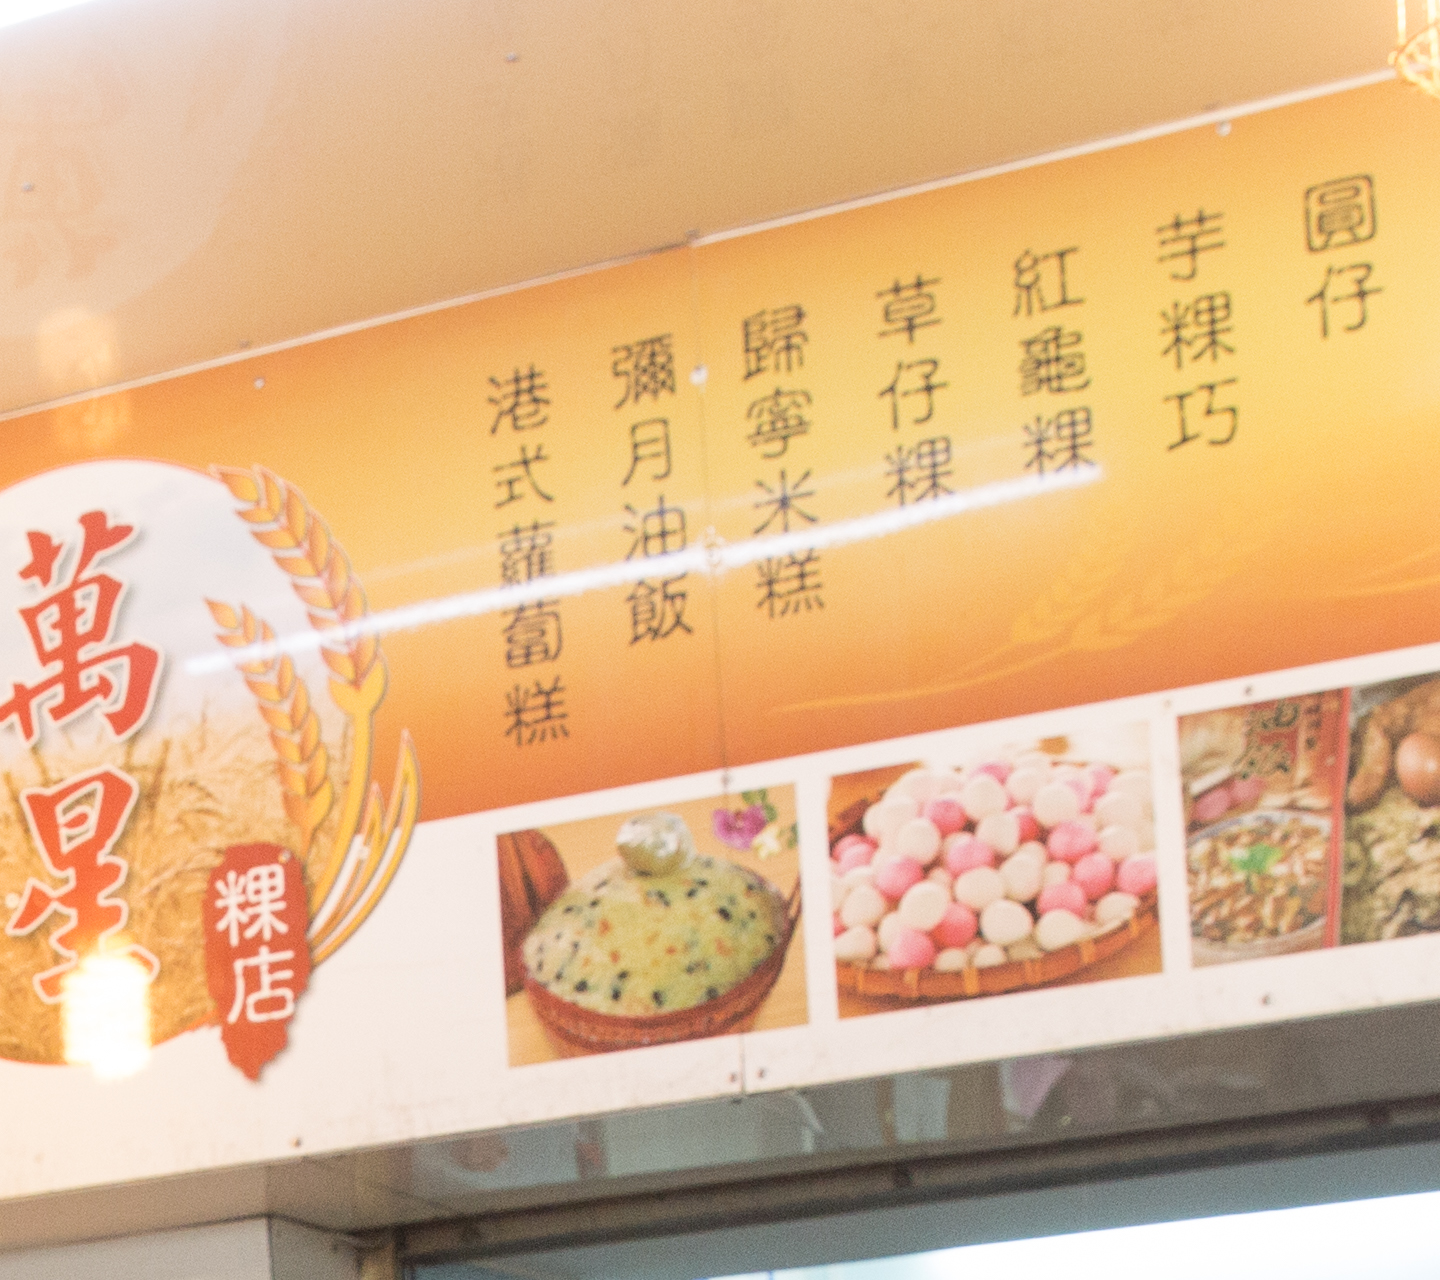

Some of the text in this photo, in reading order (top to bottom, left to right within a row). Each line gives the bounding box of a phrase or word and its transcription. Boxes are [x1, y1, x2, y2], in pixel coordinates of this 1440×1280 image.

[1012, 246, 1098, 482] 紅龜粿
[1156, 208, 1240, 453] 芋粿巧
[1302, 173, 1384, 338] 圓仔
[610, 333, 694, 646] 彌月油飯
[742, 304, 826, 620] 歸寧米糕
[875, 274, 959, 508] 草仔粿
[486, 363, 571, 748] 港式蘿蔔糕
[213, 861, 296, 1026] 粿店
